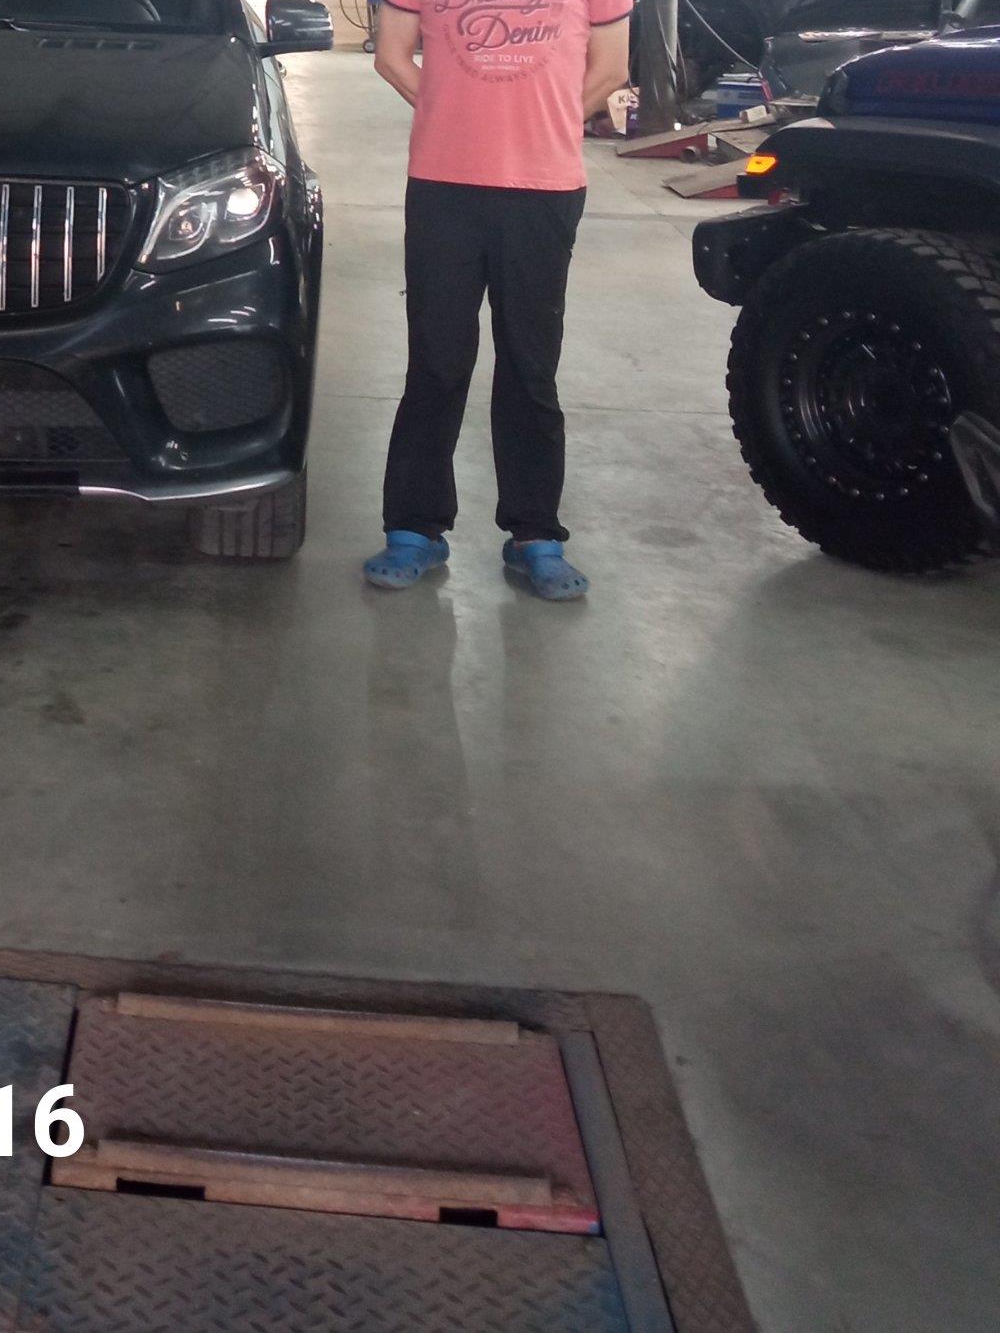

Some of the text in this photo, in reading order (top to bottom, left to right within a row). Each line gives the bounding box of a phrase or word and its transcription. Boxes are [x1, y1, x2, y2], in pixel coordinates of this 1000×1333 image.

[464, 11, 562, 52] Denim
[498, 54, 511, 63] TO
[513, 54, 535, 64] LIVE
